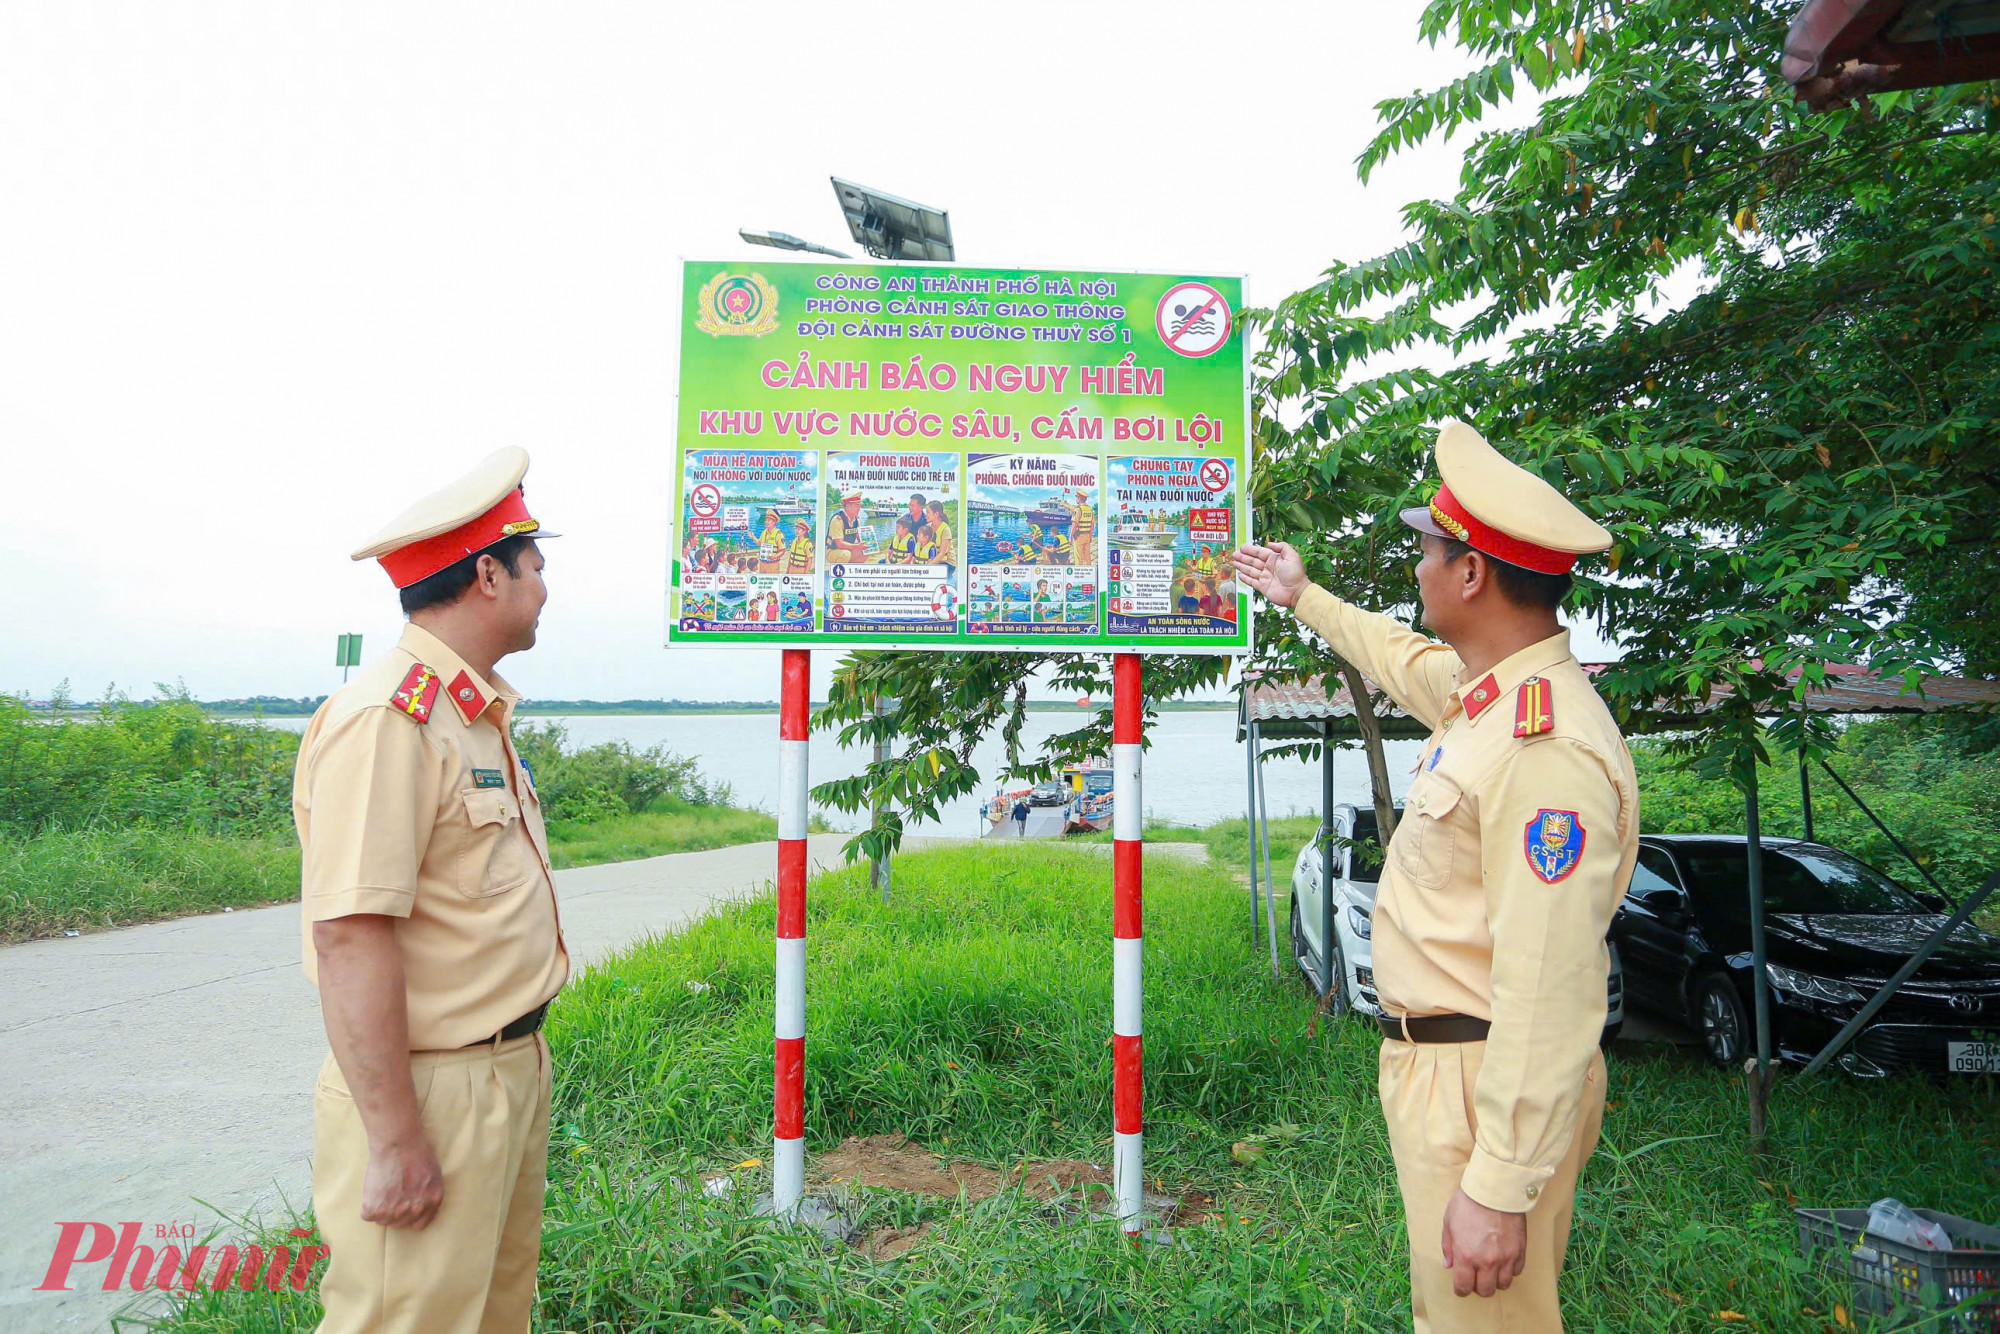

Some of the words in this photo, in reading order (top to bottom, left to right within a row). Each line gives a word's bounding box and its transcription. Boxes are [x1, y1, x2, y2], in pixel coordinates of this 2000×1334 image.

[816, 273, 880, 290] CÔNG
[886, 278, 915, 291] AN
[921, 275, 988, 293] THÀNH
[996, 275, 1039, 294] PHỐ
[1045, 278, 1073, 295] HÀ
[1080, 279, 1116, 299] NỘI
[806, 296, 881, 313] PHÒNG
[887, 296, 947, 315] CẢNH
[953, 298, 989, 316] SÁT
[995, 303, 1048, 317] GIAO
[1054, 302, 1125, 319] THÔNG
[798, 319, 835, 340] ĐỘI
[842, 319, 902, 337] CẢNH
[908, 321, 944, 338] SÁT
[950, 323, 1026, 340] ĐƯỜNG
[1032, 323, 1083, 341] THUỶ
[1088, 323, 1116, 342] SỐ
[1122, 329, 1130, 342] 1
[761, 350, 868, 389] CẢNH
[880, 354, 957, 391] BÁO
[968, 364, 1069, 393] NGUY
[1080, 352, 1164, 395] HIỂM
[699, 410, 762, 435] KHU
[772, 408, 840, 442] VỰC
[850, 406, 943, 437] NƯỚC
[951, 408, 1020, 443] SÂU,
[1030, 406, 1103, 440] CẤM
[1113, 415, 1165, 442] BƠI
[1175, 412, 1222, 449] LỘI
[703, 453, 728, 467] MÙA
[731, 453, 746, 467] HÈ
[749, 456, 763, 467] AN
[767, 453, 796, 468] TOÀN
[859, 453, 896, 467] PHÒNG
[900, 454, 930, 467] NGỪA
[1010, 456, 1023, 470] KỸ
[1027, 456, 1056, 470] NĂNG
[1133, 460, 1170, 471] CHUNG
[1174, 461, 1194, 472] TAY
[711, 468, 746, 480] KHÔNG
[749, 469, 763, 481] VỚI
[765, 468, 785, 481] ĐUỐI
[788, 470, 811, 481] NƯỚC
[835, 470, 847, 480] TAI
[848, 470, 865, 482] NẠN
[867, 468, 885, 480] ĐUỐI
[887, 470, 909, 481] NƯỚC
[911, 472, 926, 481] CHO
[928, 469, 942, 481] TRẺ
[944, 472, 955, 482] EM
[975, 471, 1010, 486] PHÒNG,
[1012, 470, 1044, 486] CHỐNG
[1046, 471, 1068, 486] ĐUỐI
[1070, 472, 1095, 486] NƯỚC
[1127, 472, 1164, 485] PHÒNG
[1168, 472, 1198, 486] NGỪA
[1117, 490, 1132, 501] TAI
[1136, 490, 1157, 504] NẠN
[1158, 617, 1174, 625] TOÀN
[1176, 617, 1192, 625] SÔNG
[1194, 617, 1210, 625] NƯỚC
